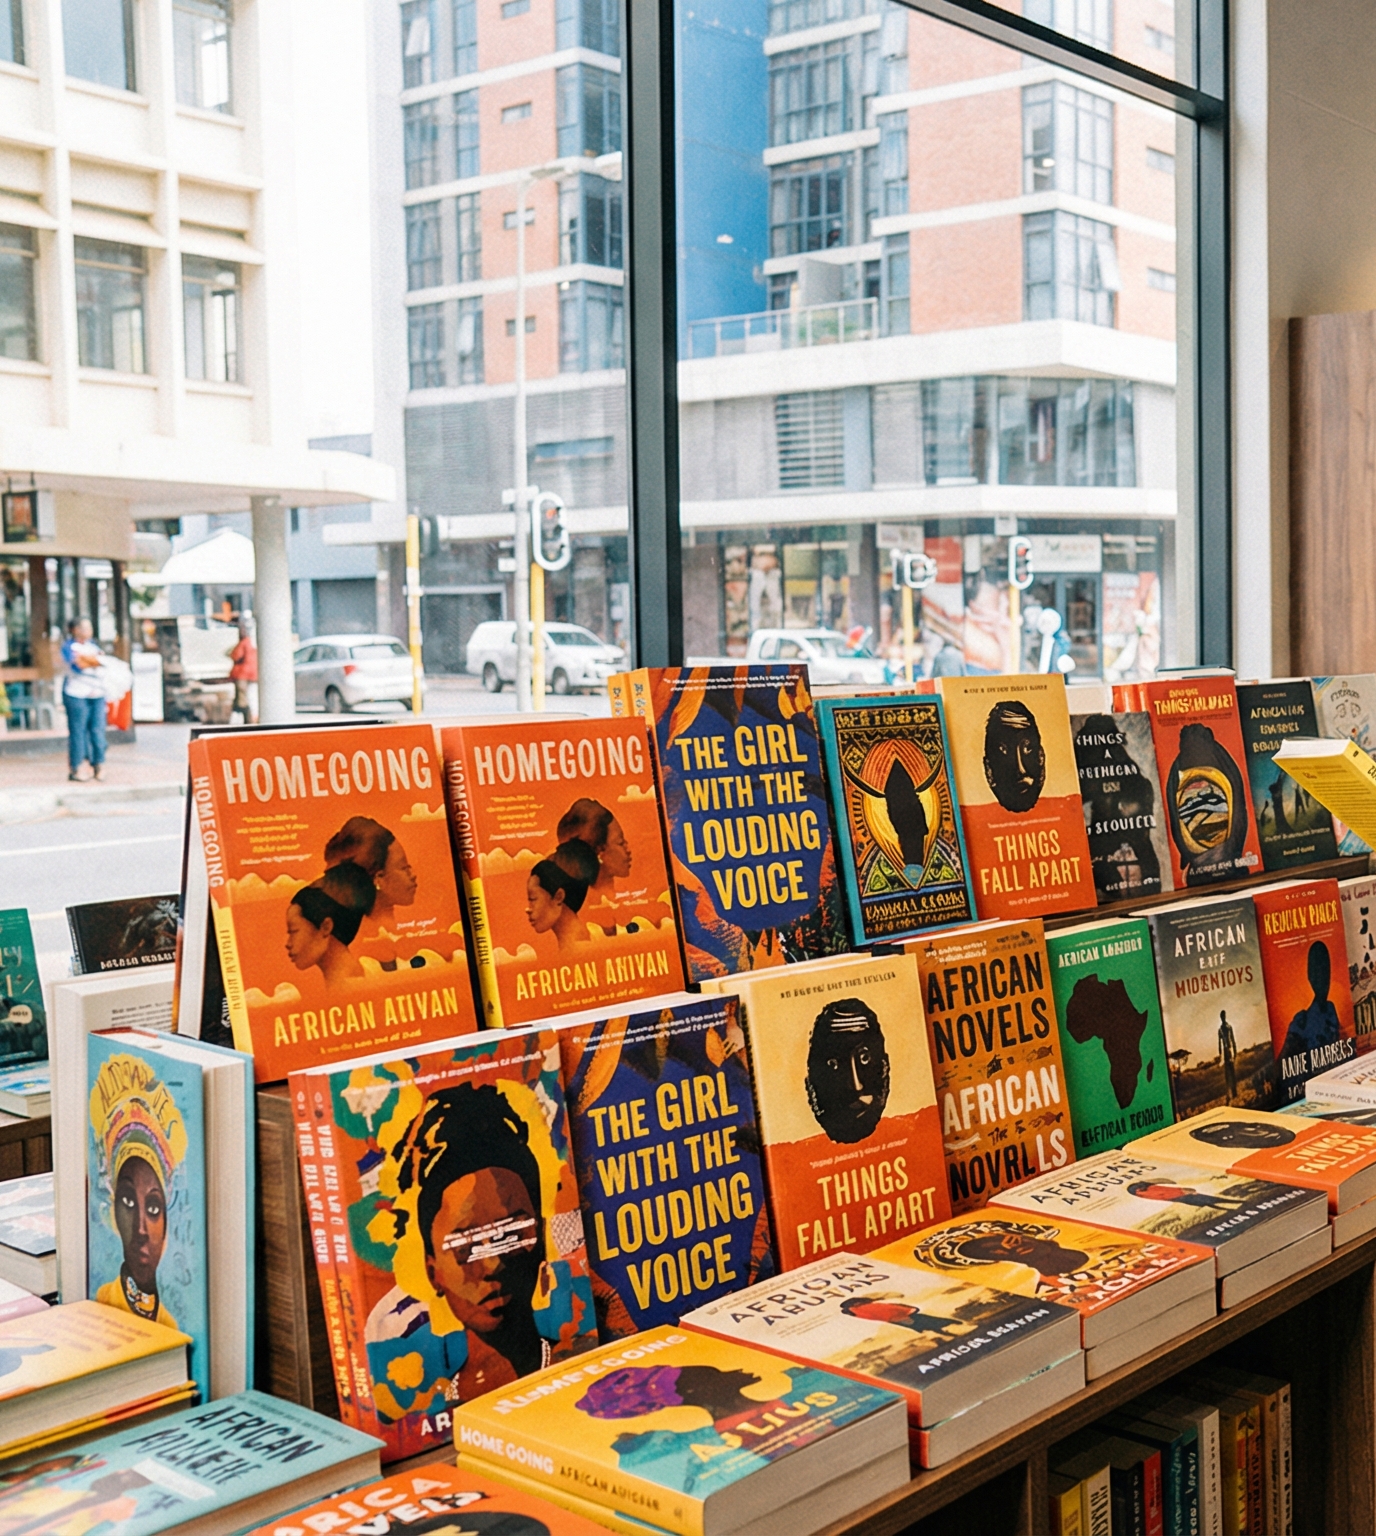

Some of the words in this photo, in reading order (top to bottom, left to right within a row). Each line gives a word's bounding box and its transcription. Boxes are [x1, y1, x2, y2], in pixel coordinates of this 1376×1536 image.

[221, 746, 432, 804] HOMEGOING
[473, 735, 644, 786] HOMEGOING
[674, 735, 729, 771] THE
[734, 723, 808, 767] GIRL
[446, 759, 475, 860] HOMEGOING
[684, 775, 754, 812] WITH
[759, 770, 808, 805] THE
[193, 775, 225, 888] HOMEGOING
[683, 809, 821, 864] LOUDING
[993, 829, 1061, 863] THINGS
[712, 860, 808, 910] VOICE
[981, 862, 1023, 895] FALL
[1029, 856, 1081, 889] APART
[1175, 923, 1246, 957] AFRICAN
[516, 961, 598, 1001] AFRICAN
[927, 951, 1044, 1014] AFRICAN
[274, 1001, 376, 1047] AFRICAN
[932, 997, 1050, 1064] NOVELS
[587, 1098, 649, 1148] THE
[656, 1071, 739, 1132] GIRL
[943, 1064, 1061, 1136] AFRICAN
[596, 1141, 678, 1197] WITH
[684, 1126, 740, 1174] THE
[816, 1156, 909, 1211] THINGS
[594, 1171, 754, 1261] LOUDING
[797, 1212, 857, 1258] FALL
[865, 1187, 936, 1239] APART
[626, 1233, 736, 1310] VOICE
